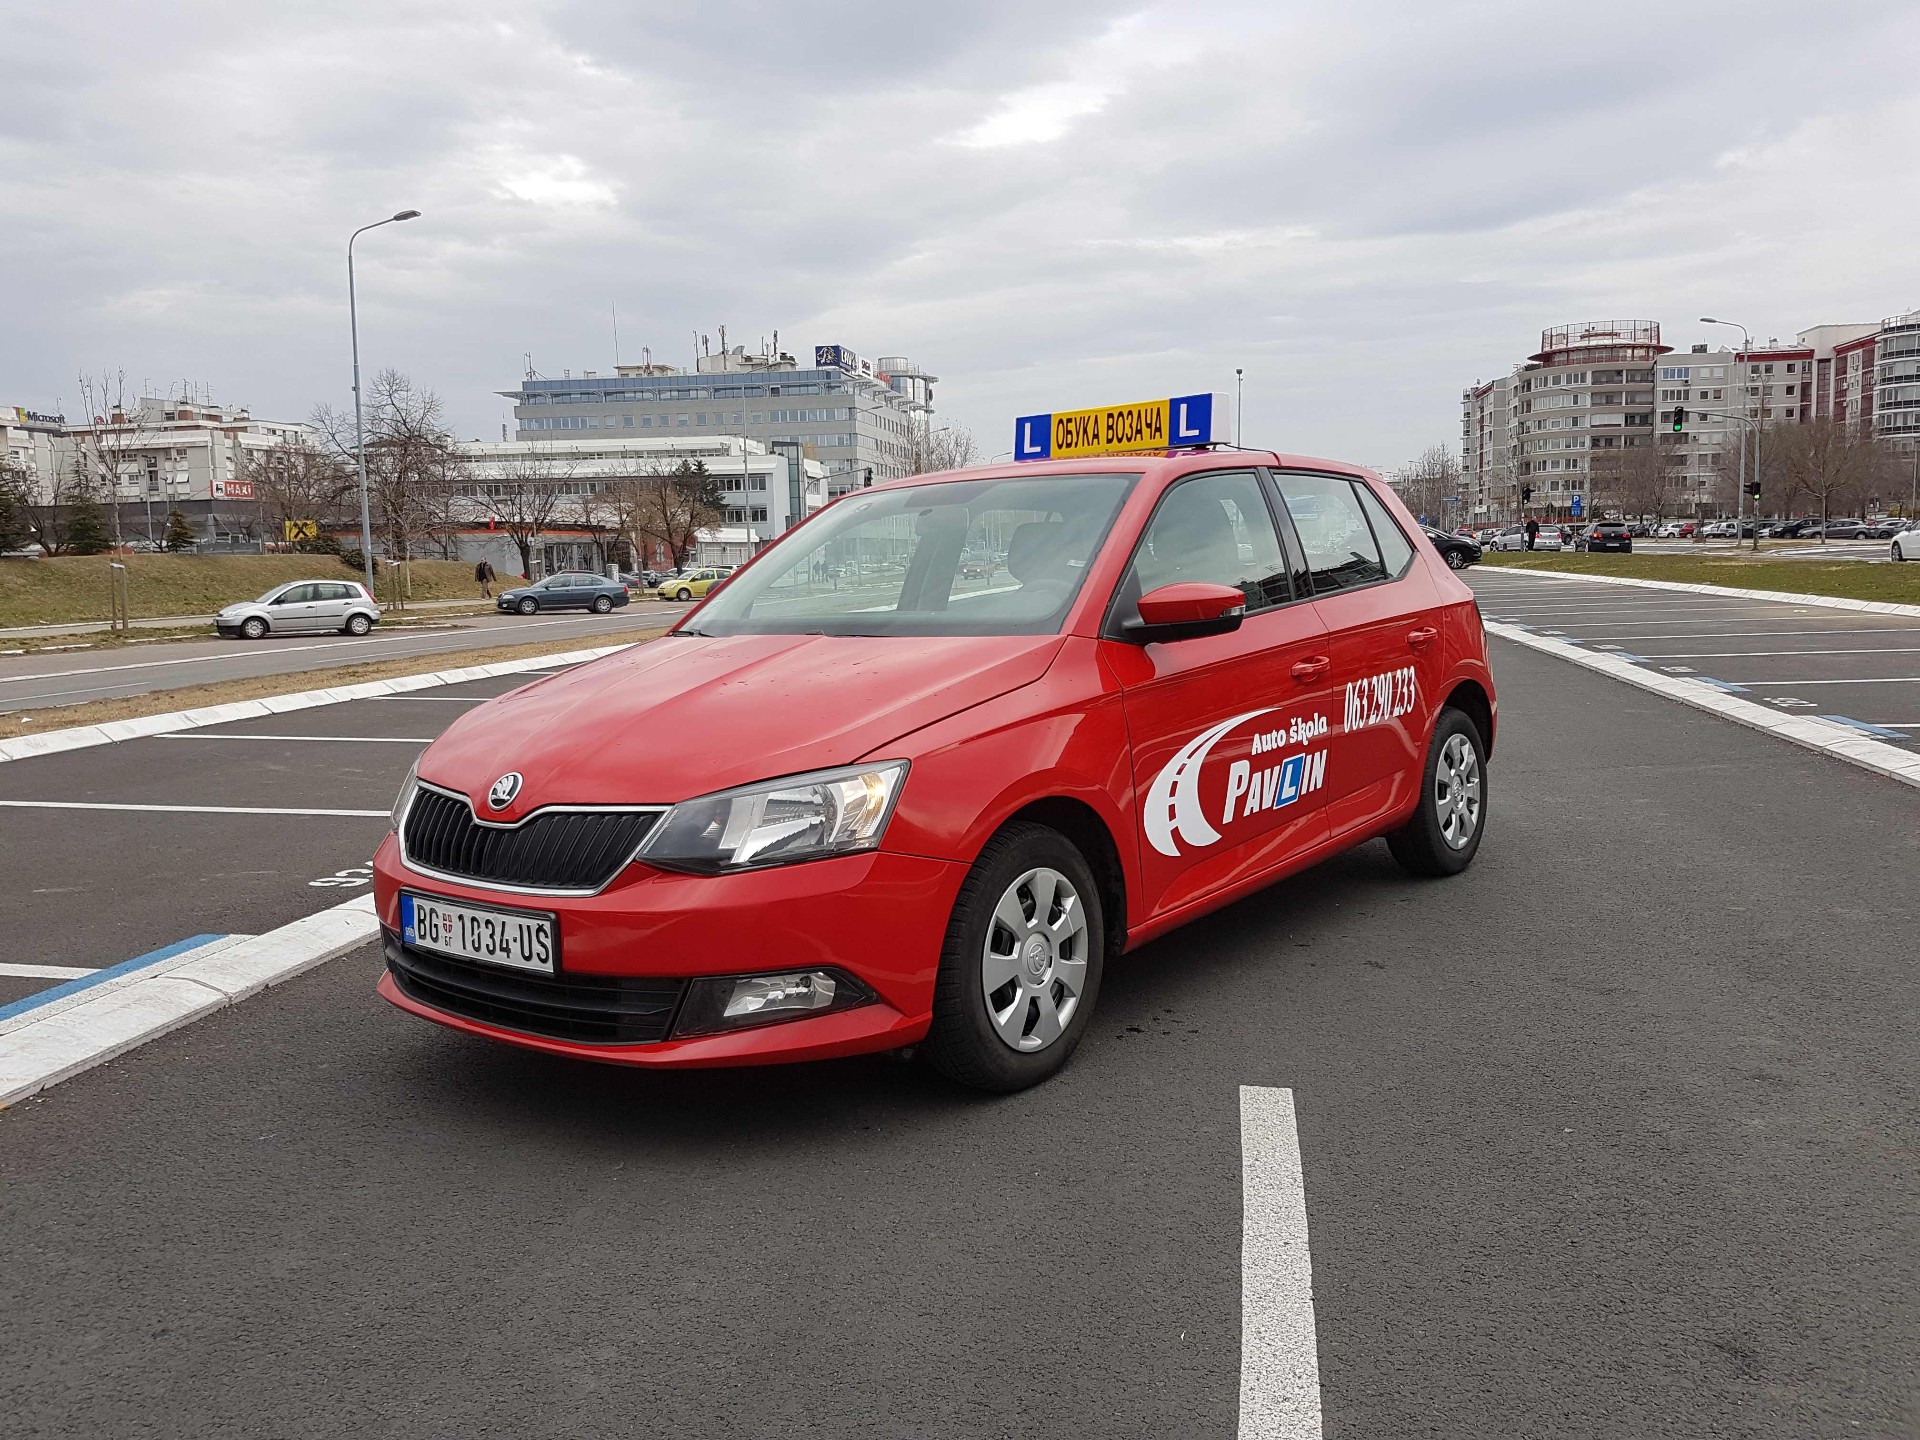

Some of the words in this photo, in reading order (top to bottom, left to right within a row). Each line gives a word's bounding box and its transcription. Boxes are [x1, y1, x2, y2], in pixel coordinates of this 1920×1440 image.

[27, 411, 65, 424] Microsoft
[1056, 415, 1100, 450] ОБУКА
[1105, 407, 1162, 445] ВОЗАЧА
[1179, 404, 1199, 437] L
[1024, 422, 1041, 454] L
[1343, 678, 1368, 733] 063
[1368, 671, 1393, 724] 290
[1393, 665, 1415, 717] 233
[1251, 729, 1287, 756] Auto
[1289, 712, 1328, 746] škola
[416, 903, 439, 943] BG
